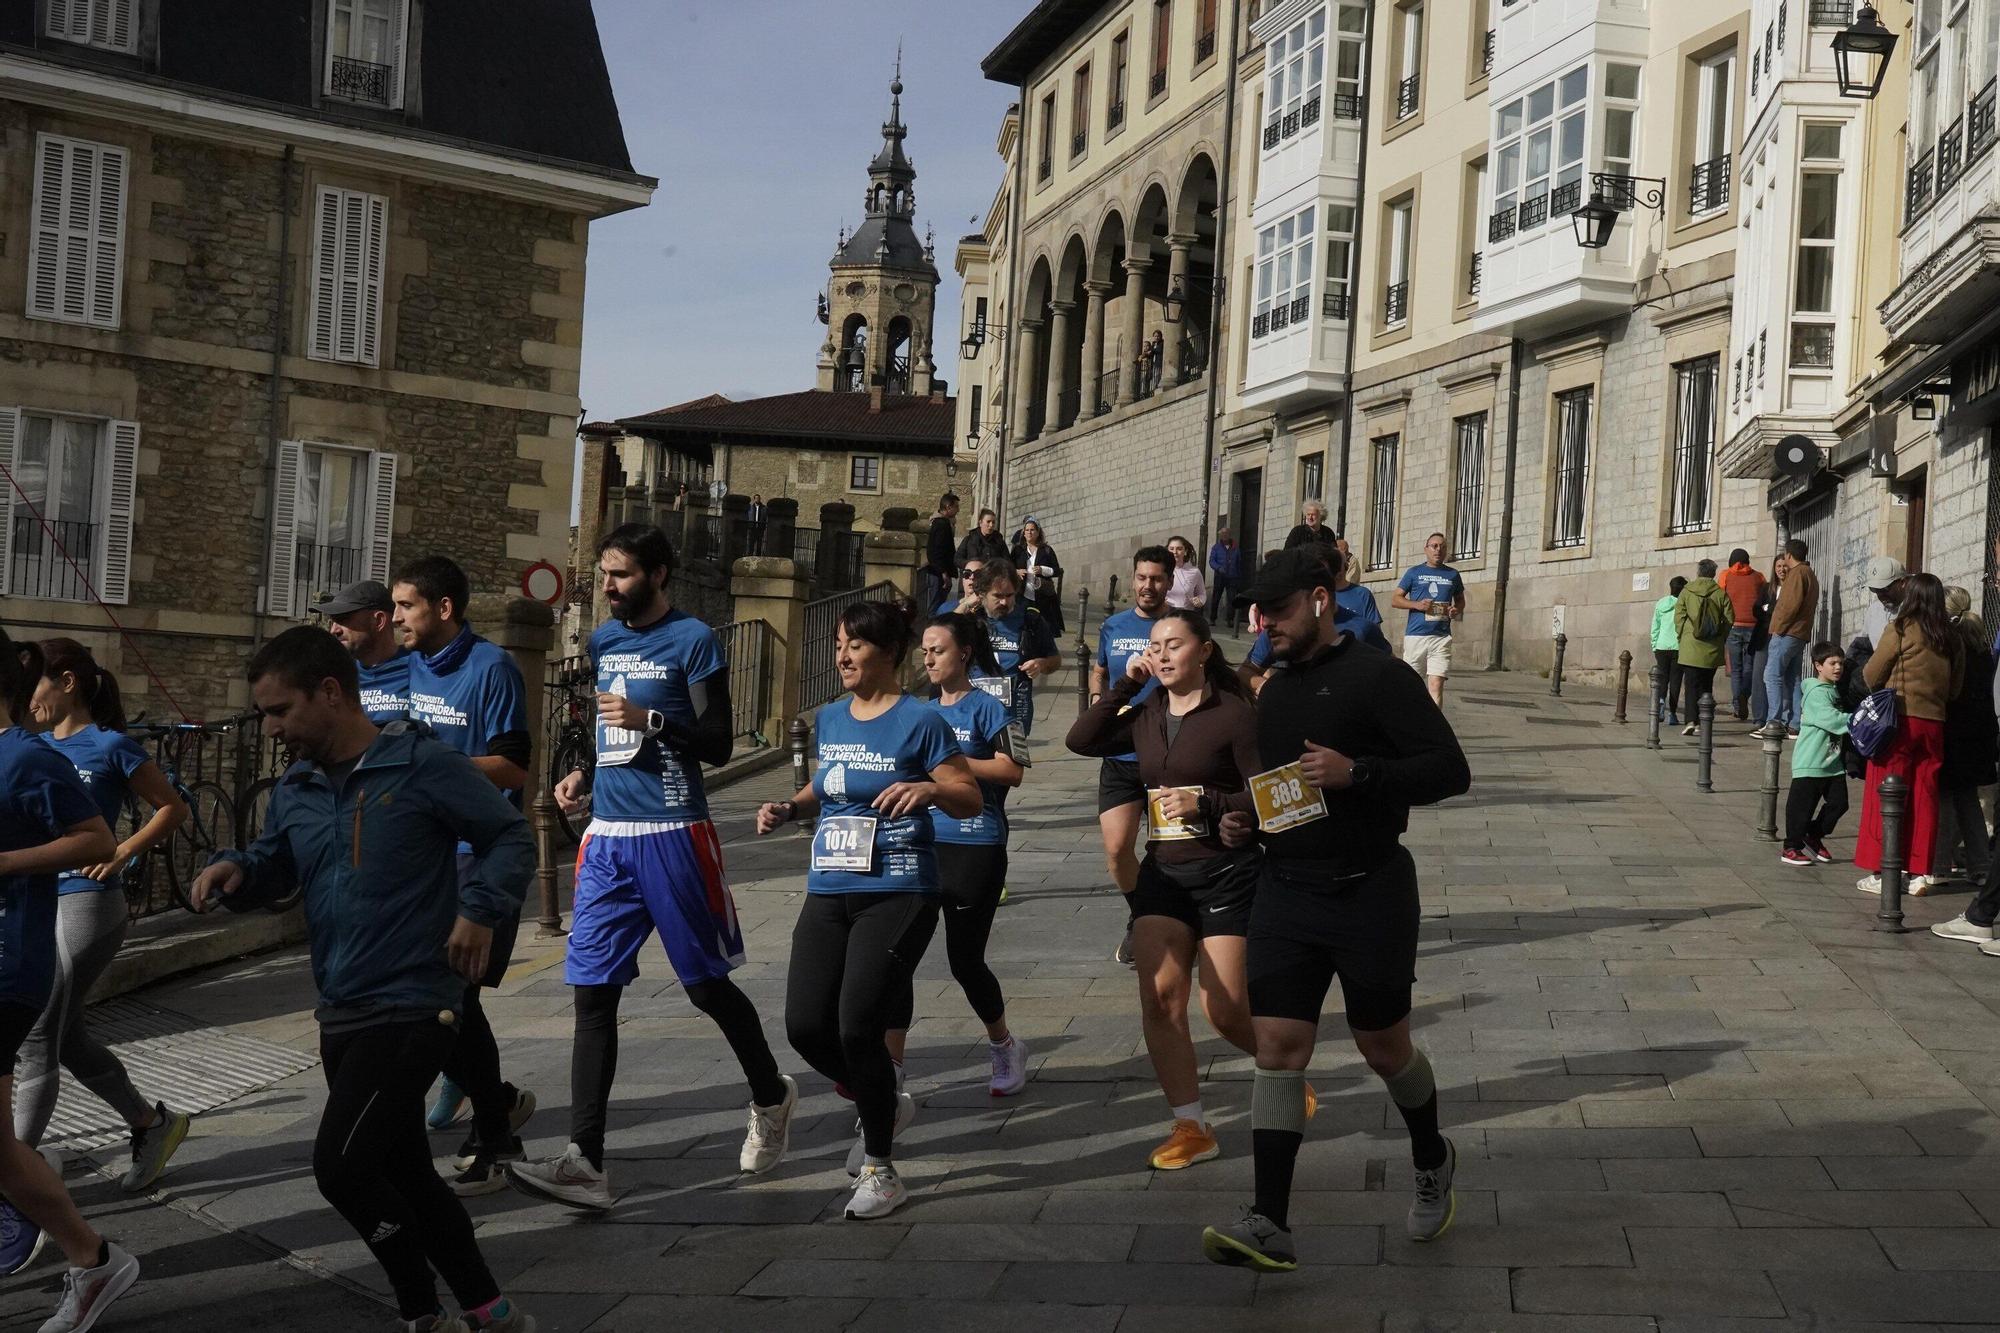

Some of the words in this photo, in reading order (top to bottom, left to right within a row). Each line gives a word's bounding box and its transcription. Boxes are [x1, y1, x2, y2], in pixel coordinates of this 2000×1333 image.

[1897, 495, 1904, 504] 2
[604, 654, 641, 663] CONQUISTA
[603, 661, 655, 672] ALMENDRA
[627, 671, 667, 680] KONKISTA
[360, 689, 382, 697] UISTA
[977, 685, 1003, 697] 046
[360, 694, 397, 705] ENDRA
[416, 693, 445, 706] CONQUISTA
[367, 704, 409, 712] KONKISTA
[415, 702, 456, 717] ALMENDRA
[432, 714, 468, 726] KONKISTA
[819, 743, 827, 751] LA
[827, 743, 866, 752] CONQUISTA
[823, 751, 882, 763] ALMENDRA
[847, 762, 896, 772] KONKISTA
[1270, 778, 1303, 808] 388
[824, 830, 858, 850] 1074
